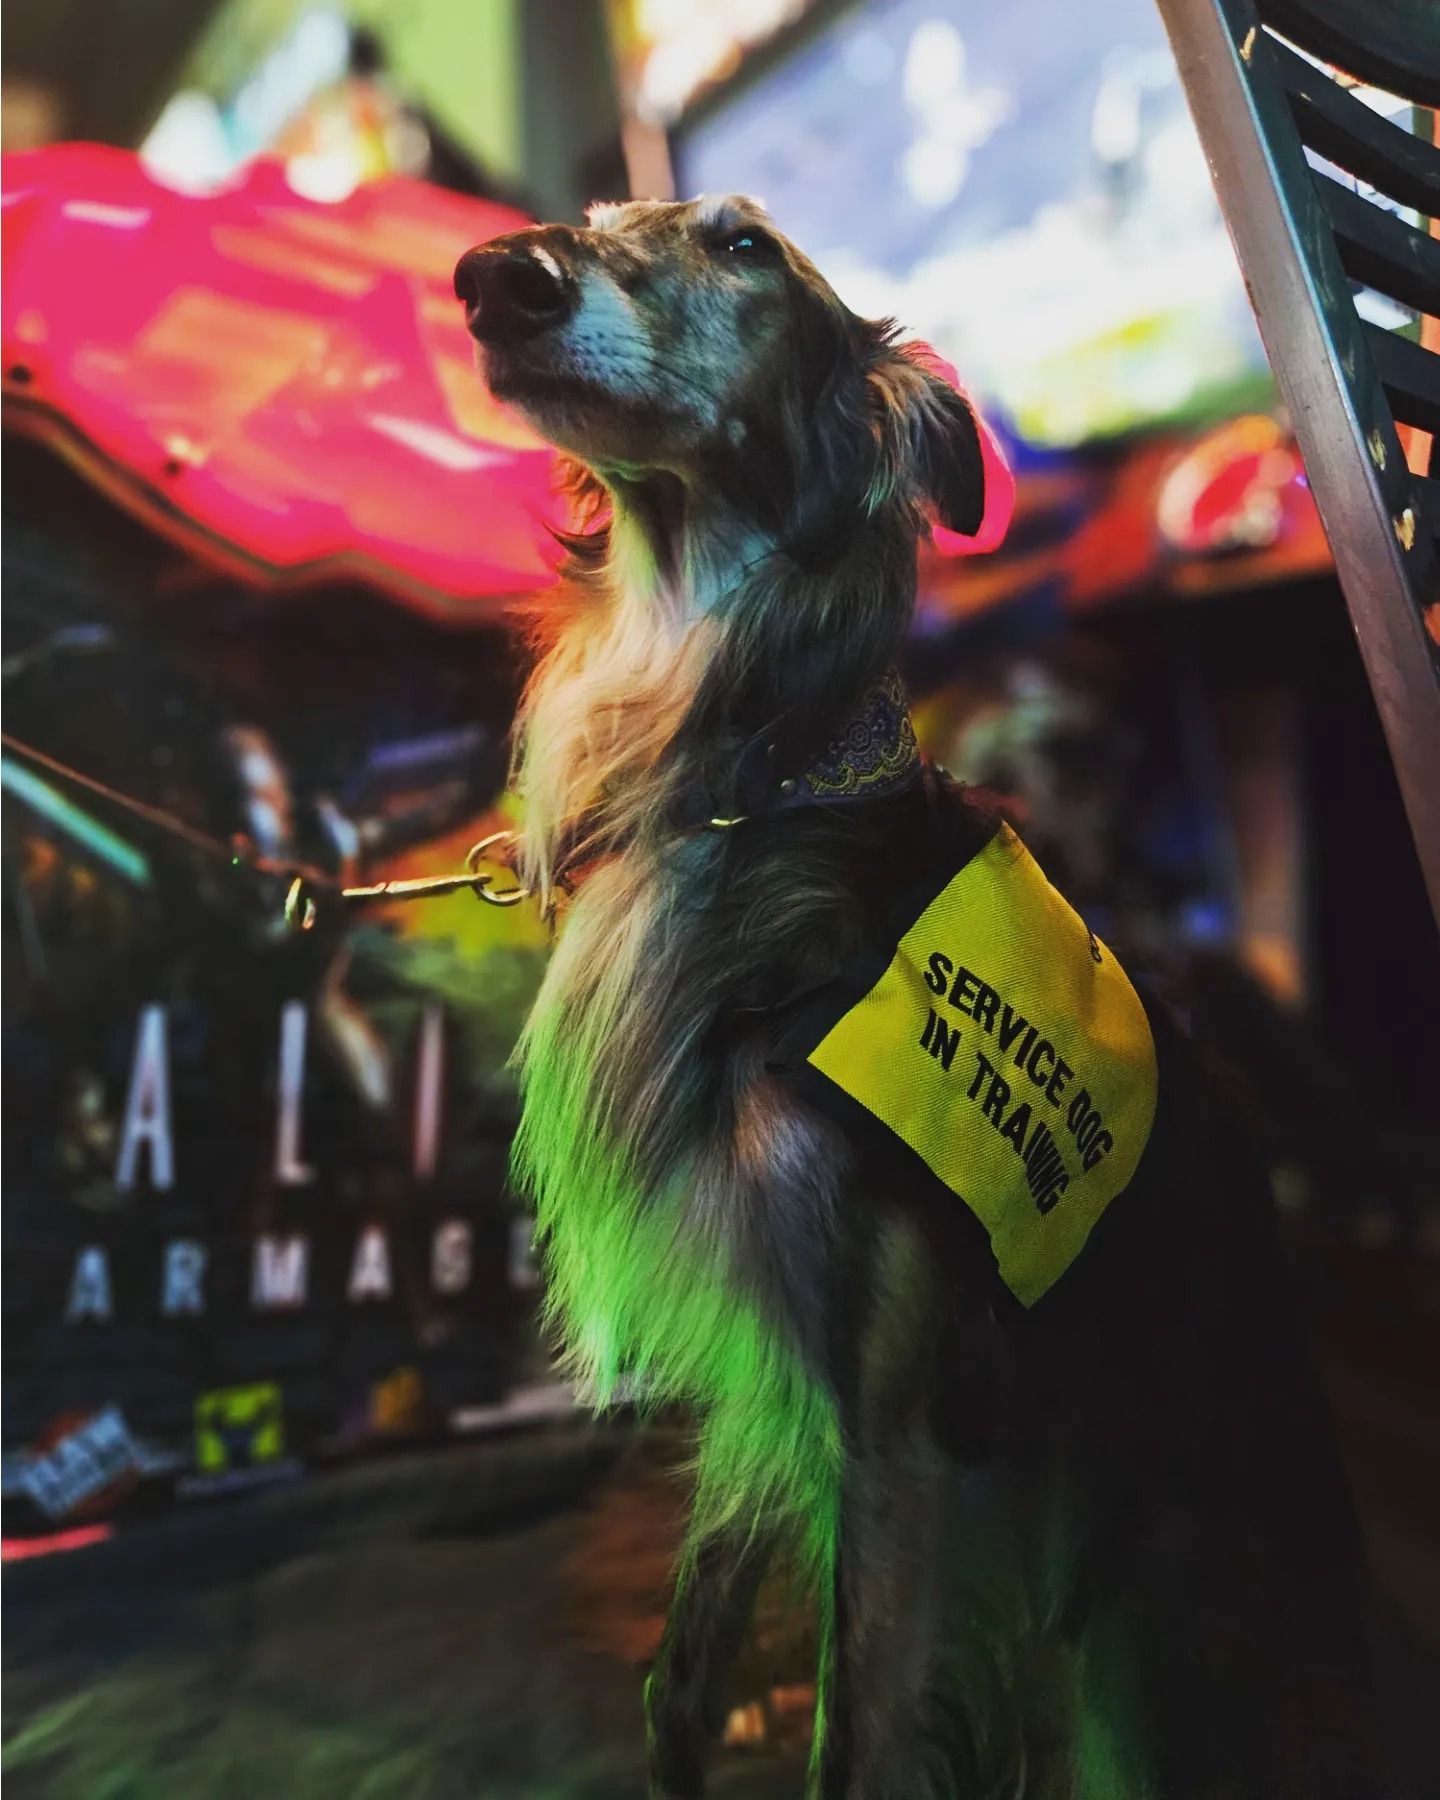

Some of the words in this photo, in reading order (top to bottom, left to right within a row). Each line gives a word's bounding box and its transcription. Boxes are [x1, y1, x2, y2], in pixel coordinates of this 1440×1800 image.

[919, 1008, 961, 1072] IN
[966, 1052, 1071, 1216] TRAINING
[924, 951, 1074, 1106] SERVICE
[1067, 1089, 1114, 1171] DOG
